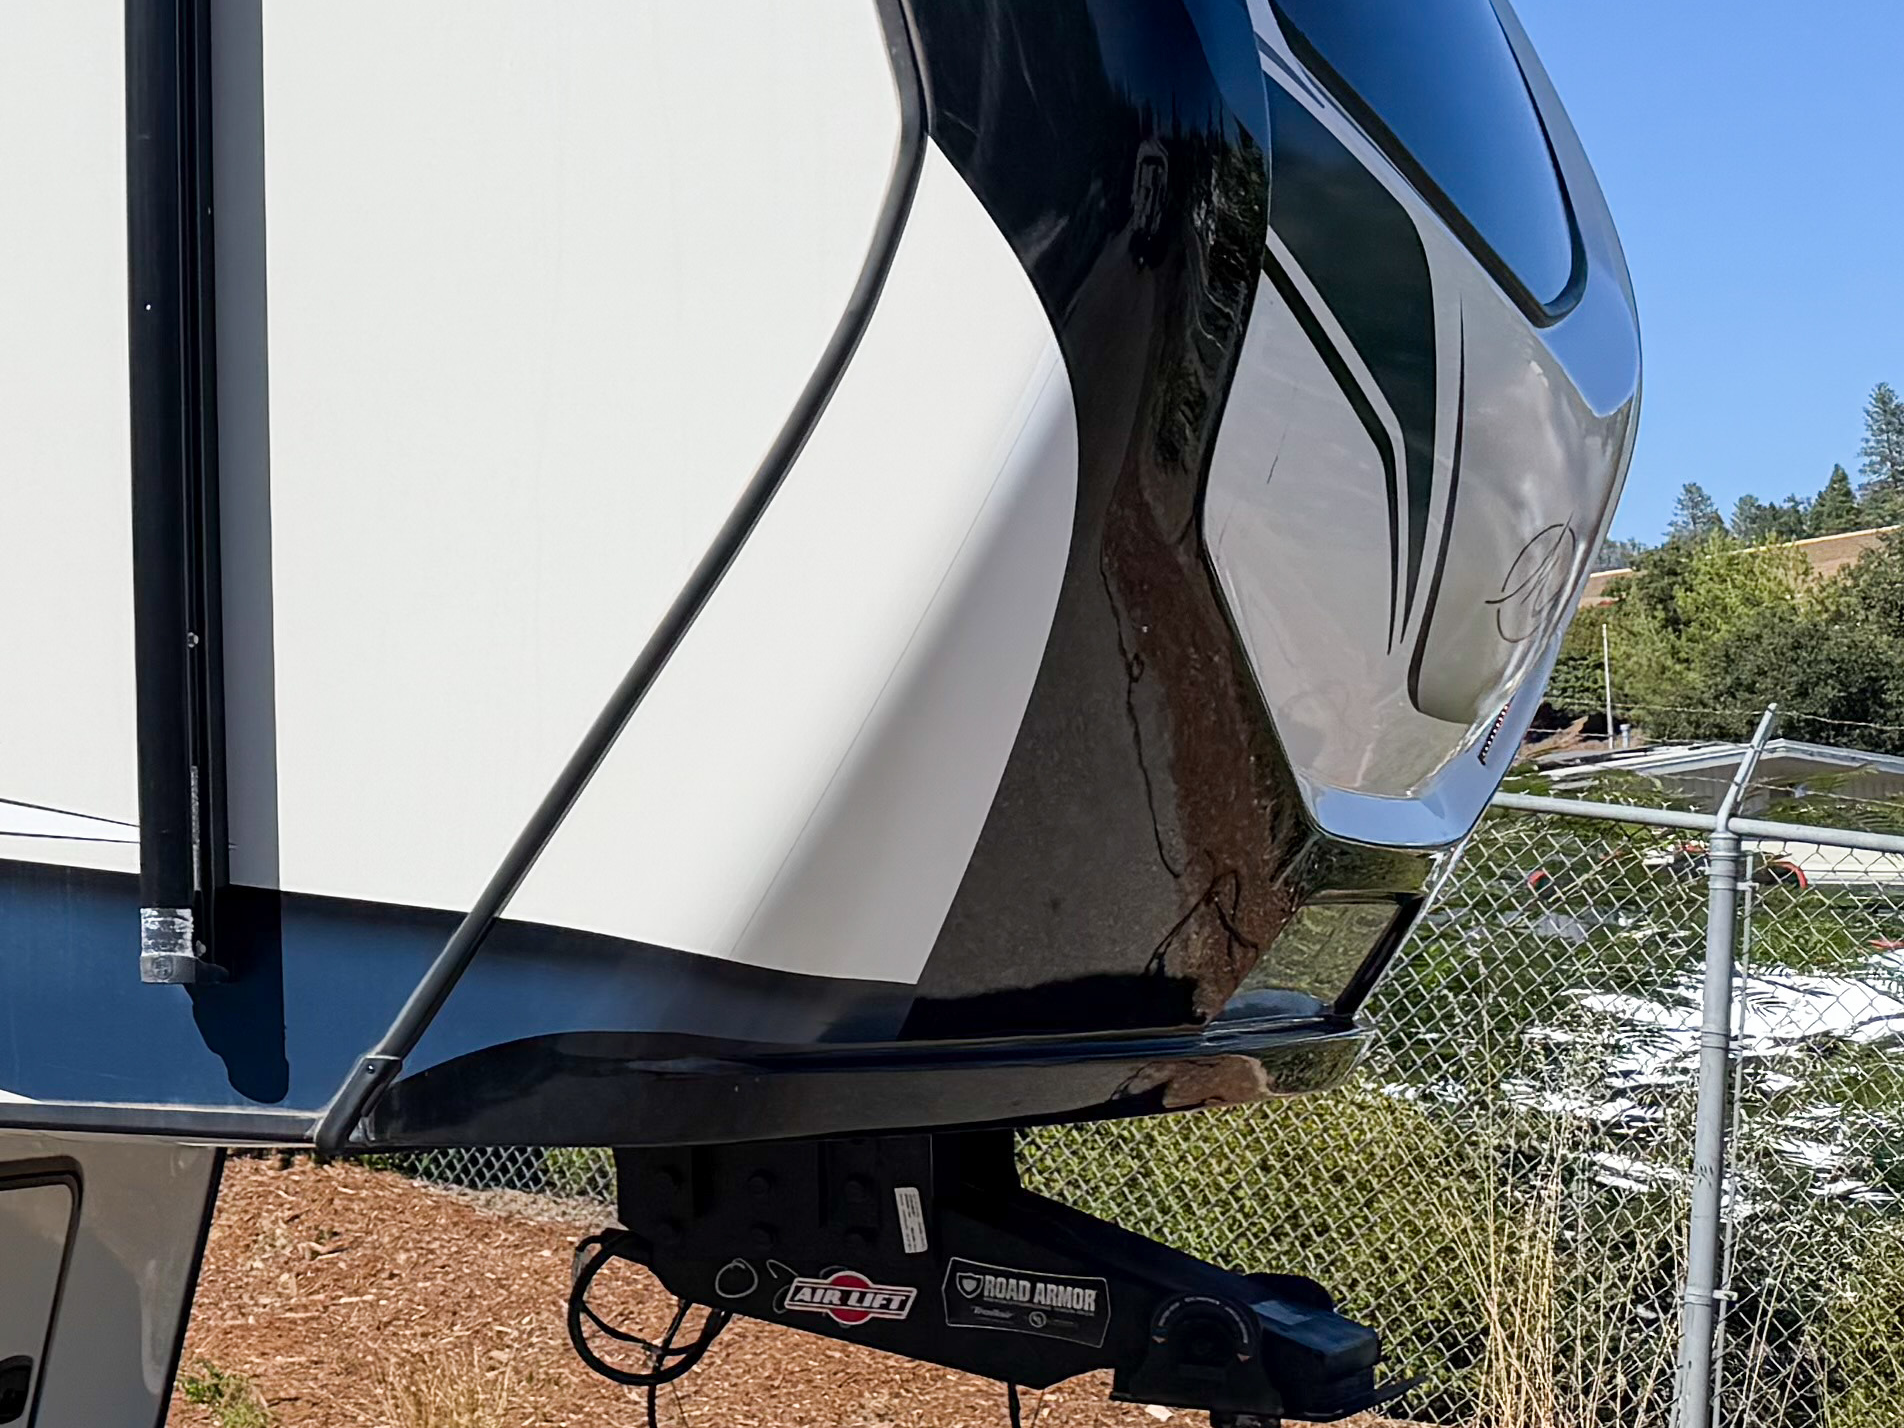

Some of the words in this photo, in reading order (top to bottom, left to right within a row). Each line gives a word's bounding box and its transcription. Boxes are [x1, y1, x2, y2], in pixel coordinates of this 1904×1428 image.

[794, 1287, 842, 1305] AIR
[847, 1291, 906, 1310] LIFT
[983, 1275, 1031, 1302] ROAD
[1033, 1282, 1097, 1311] ARMOR
